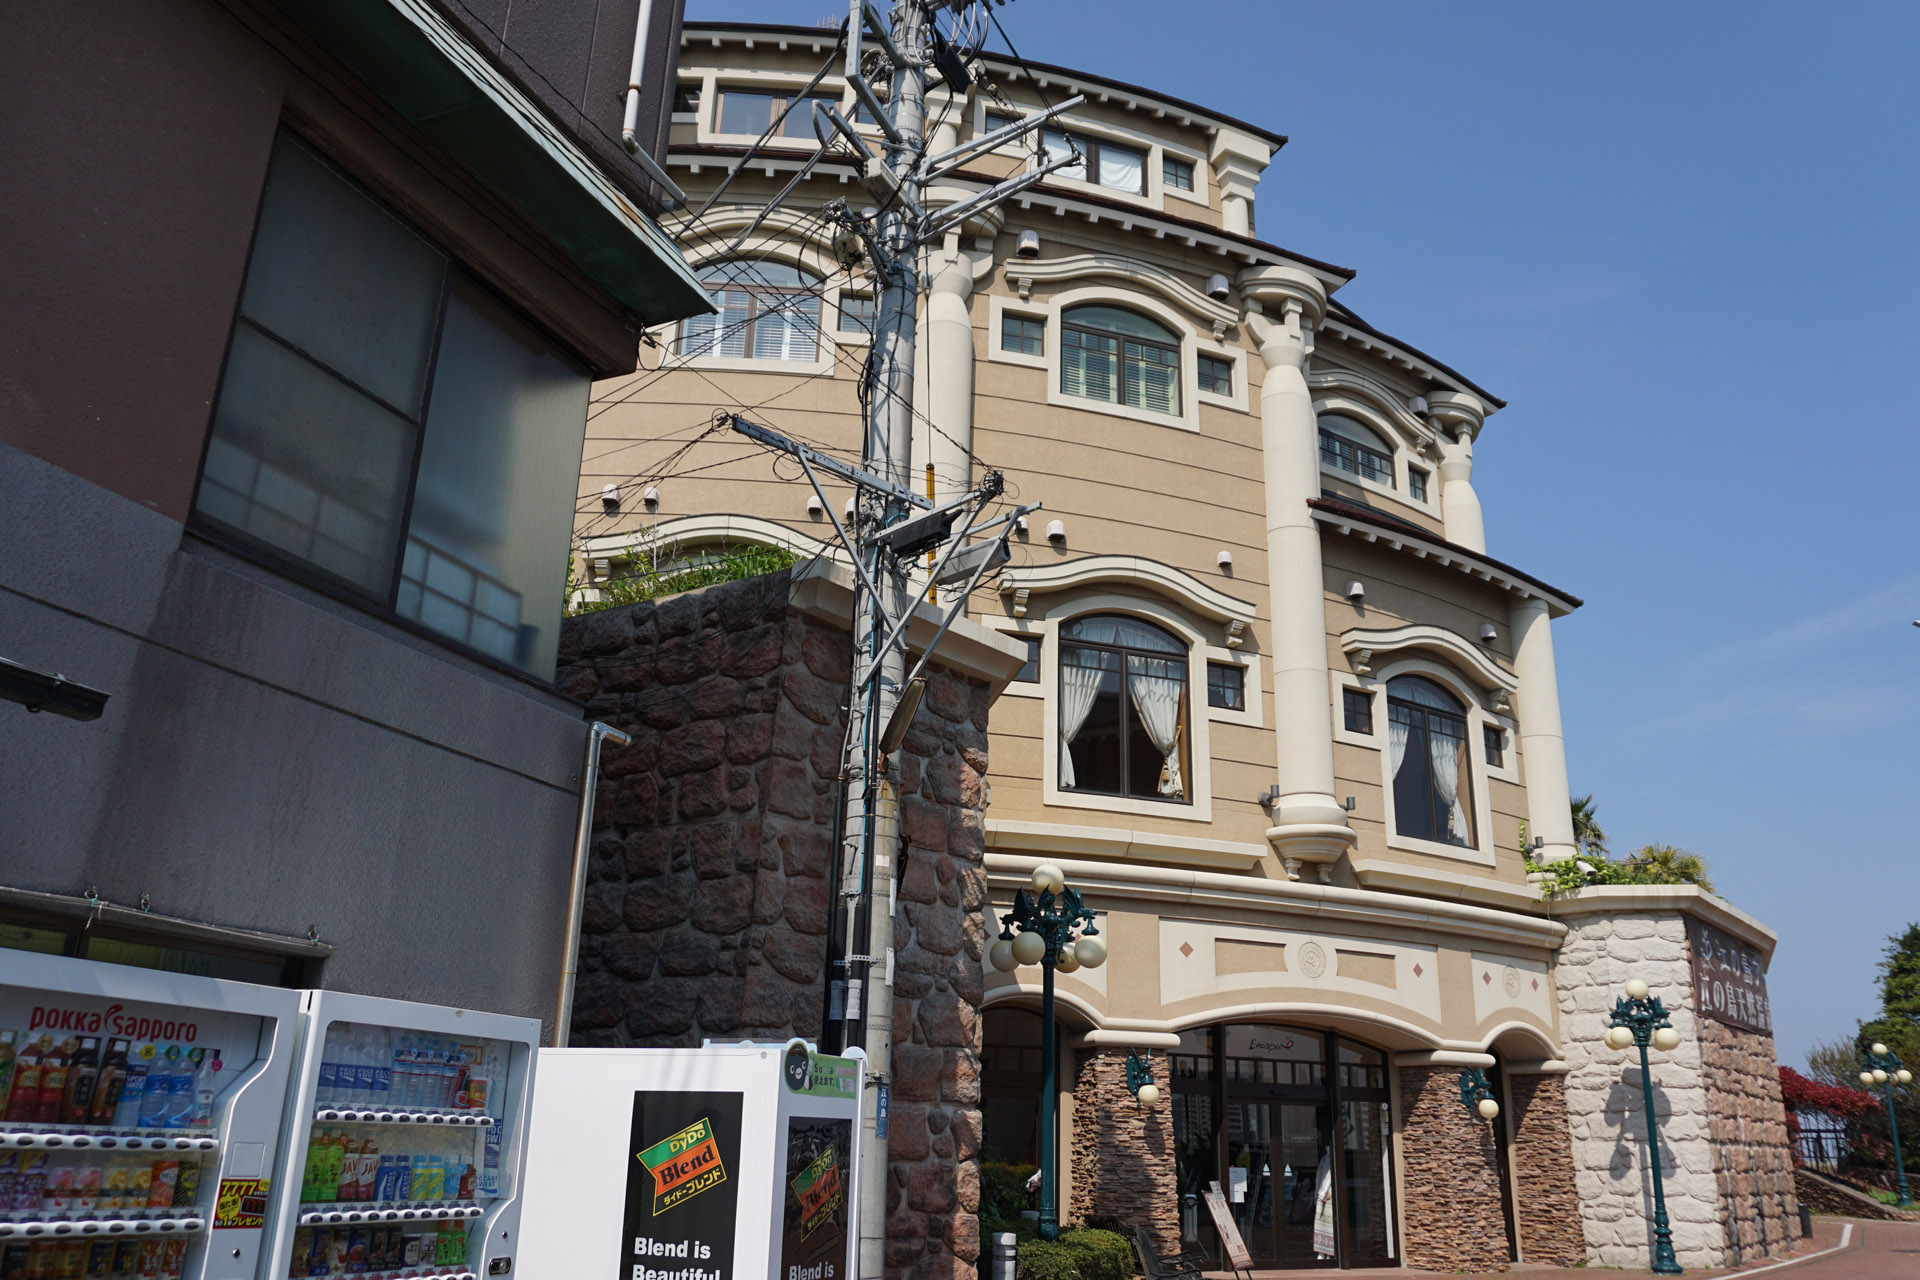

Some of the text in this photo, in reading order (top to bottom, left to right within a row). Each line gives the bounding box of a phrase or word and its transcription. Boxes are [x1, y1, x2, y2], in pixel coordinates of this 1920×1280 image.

[669, 1126, 706, 1153] DyDo
[658, 1144, 716, 1186] Blend
[222, 1181, 258, 1196] 7777
[664, 1168, 721, 1205] ダイドーブレンド
[805, 1168, 837, 1213] Blend
[634, 1237, 711, 1259] Blend is
[632, 1264, 721, 1280] Beautiful
[789, 1261, 834, 1280] Blend is
